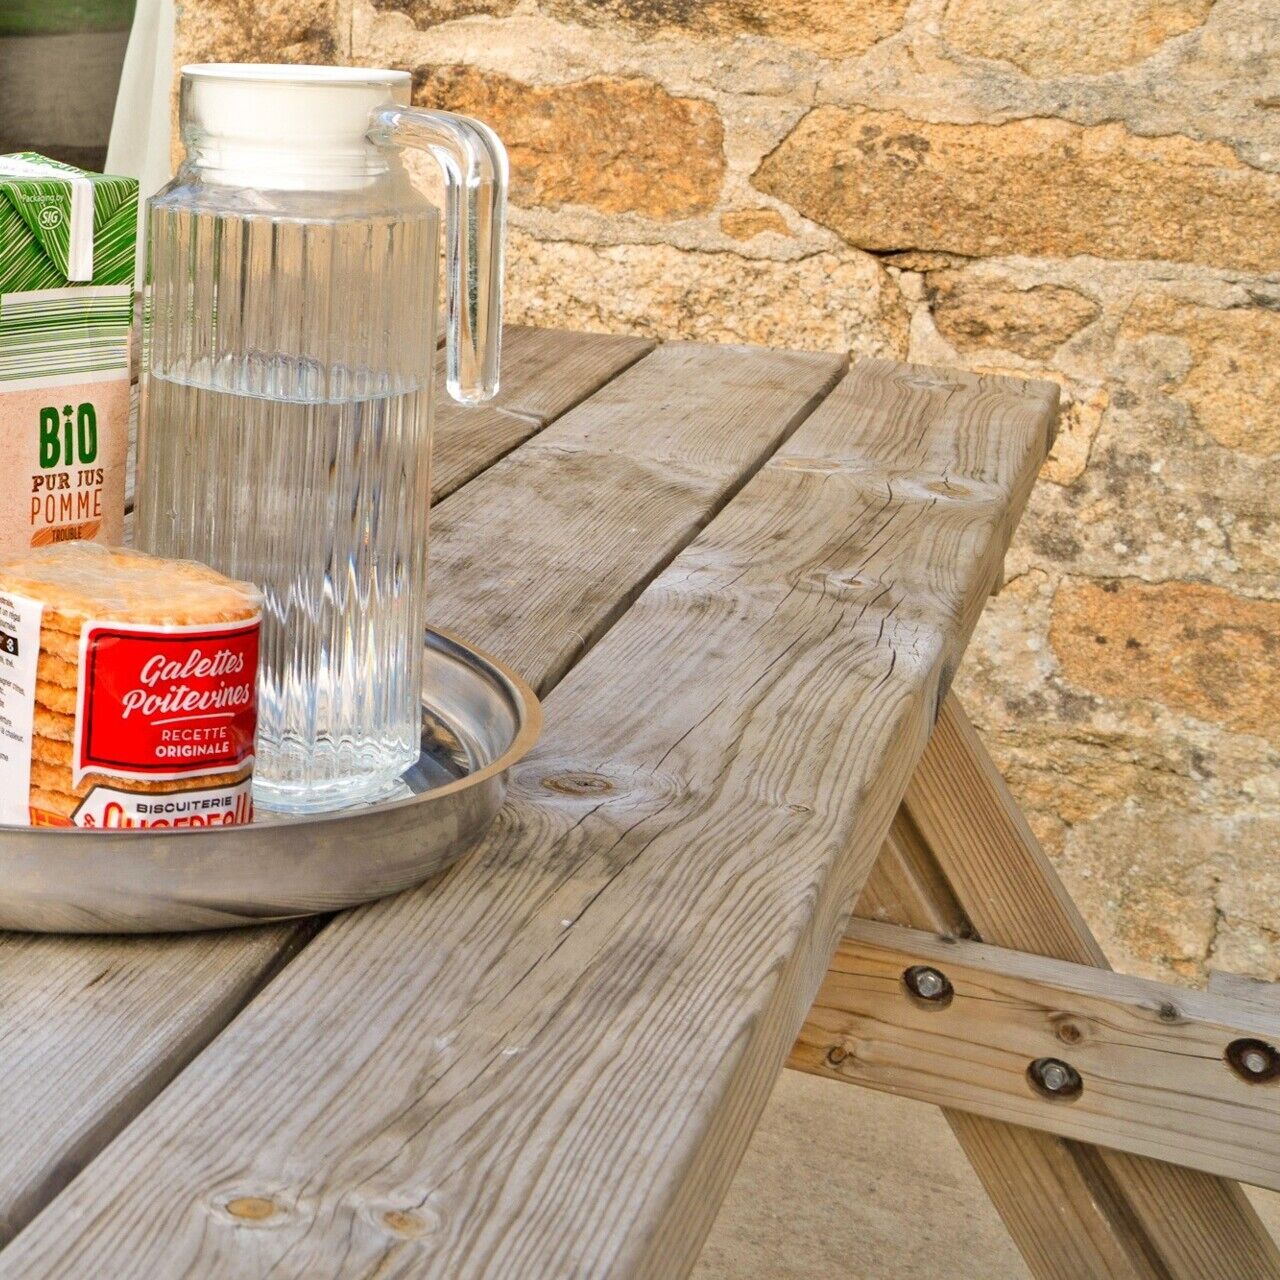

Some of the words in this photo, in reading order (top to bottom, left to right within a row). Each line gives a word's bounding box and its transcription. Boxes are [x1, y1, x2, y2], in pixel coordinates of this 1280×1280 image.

[42, 210, 59, 225] SIG
[31, 472, 71, 493] PUR
[76, 468, 104, 487] JUS
[31, 488, 102, 525] POMME
[52, 525, 82, 543] TROUBLE
[140, 648, 244, 687] Galettes
[122, 680, 249, 719] Poitevines
[161, 726, 228, 741] RECETTE
[155, 741, 230, 758] ORIGINALE
[136, 796, 233, 814] BISCUITERIE
